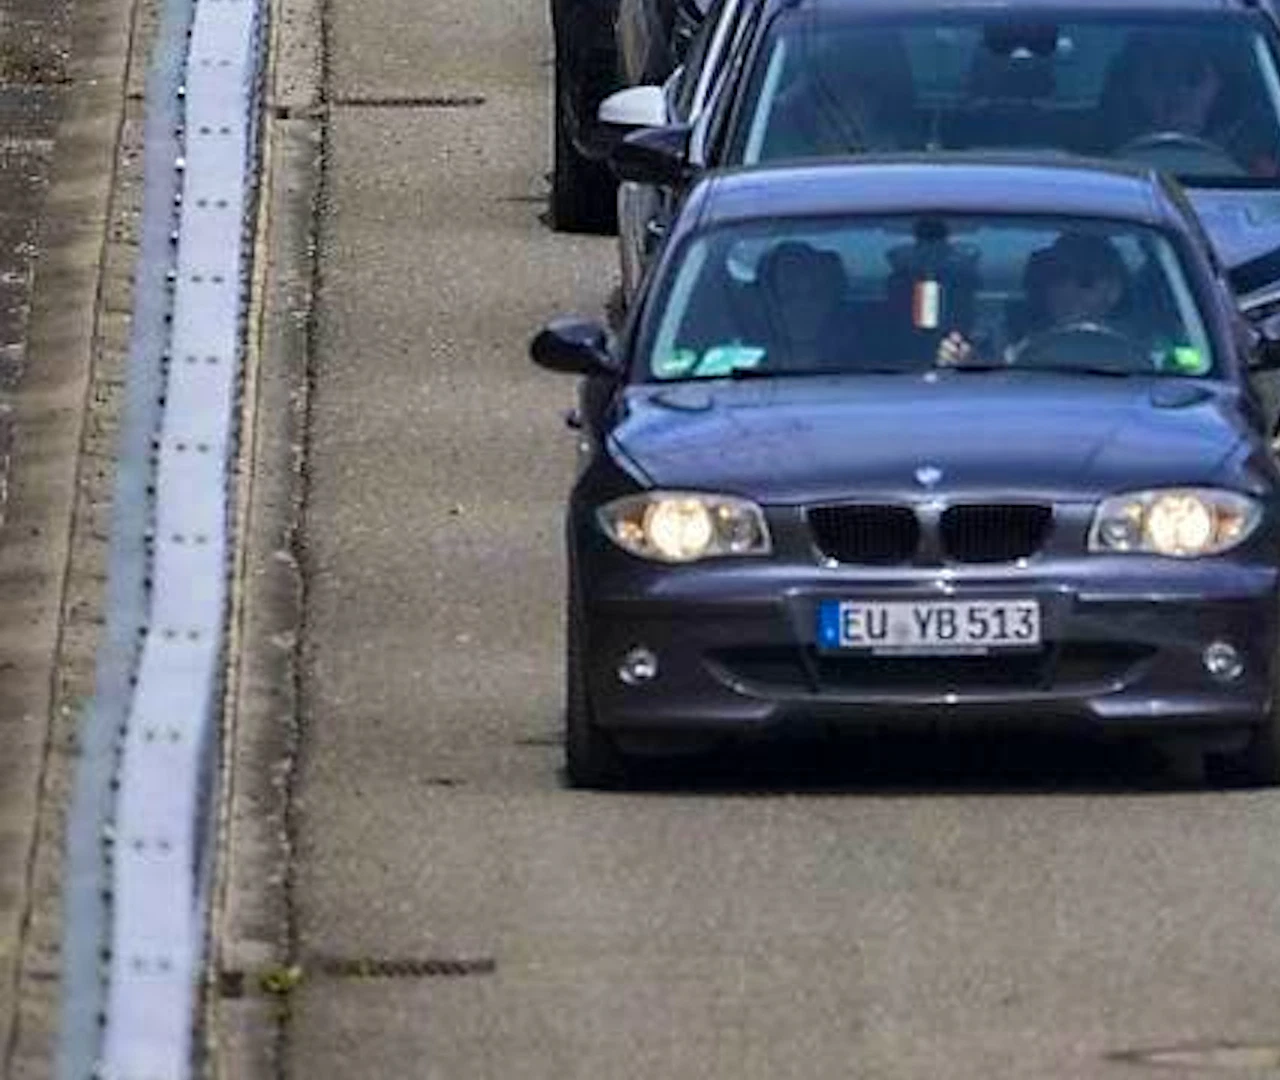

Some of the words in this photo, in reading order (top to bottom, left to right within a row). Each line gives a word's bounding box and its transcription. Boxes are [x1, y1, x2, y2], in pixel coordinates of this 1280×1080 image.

[843, 608, 888, 641] EU
[913, 608, 958, 641] YB
[968, 607, 1034, 641] 513
